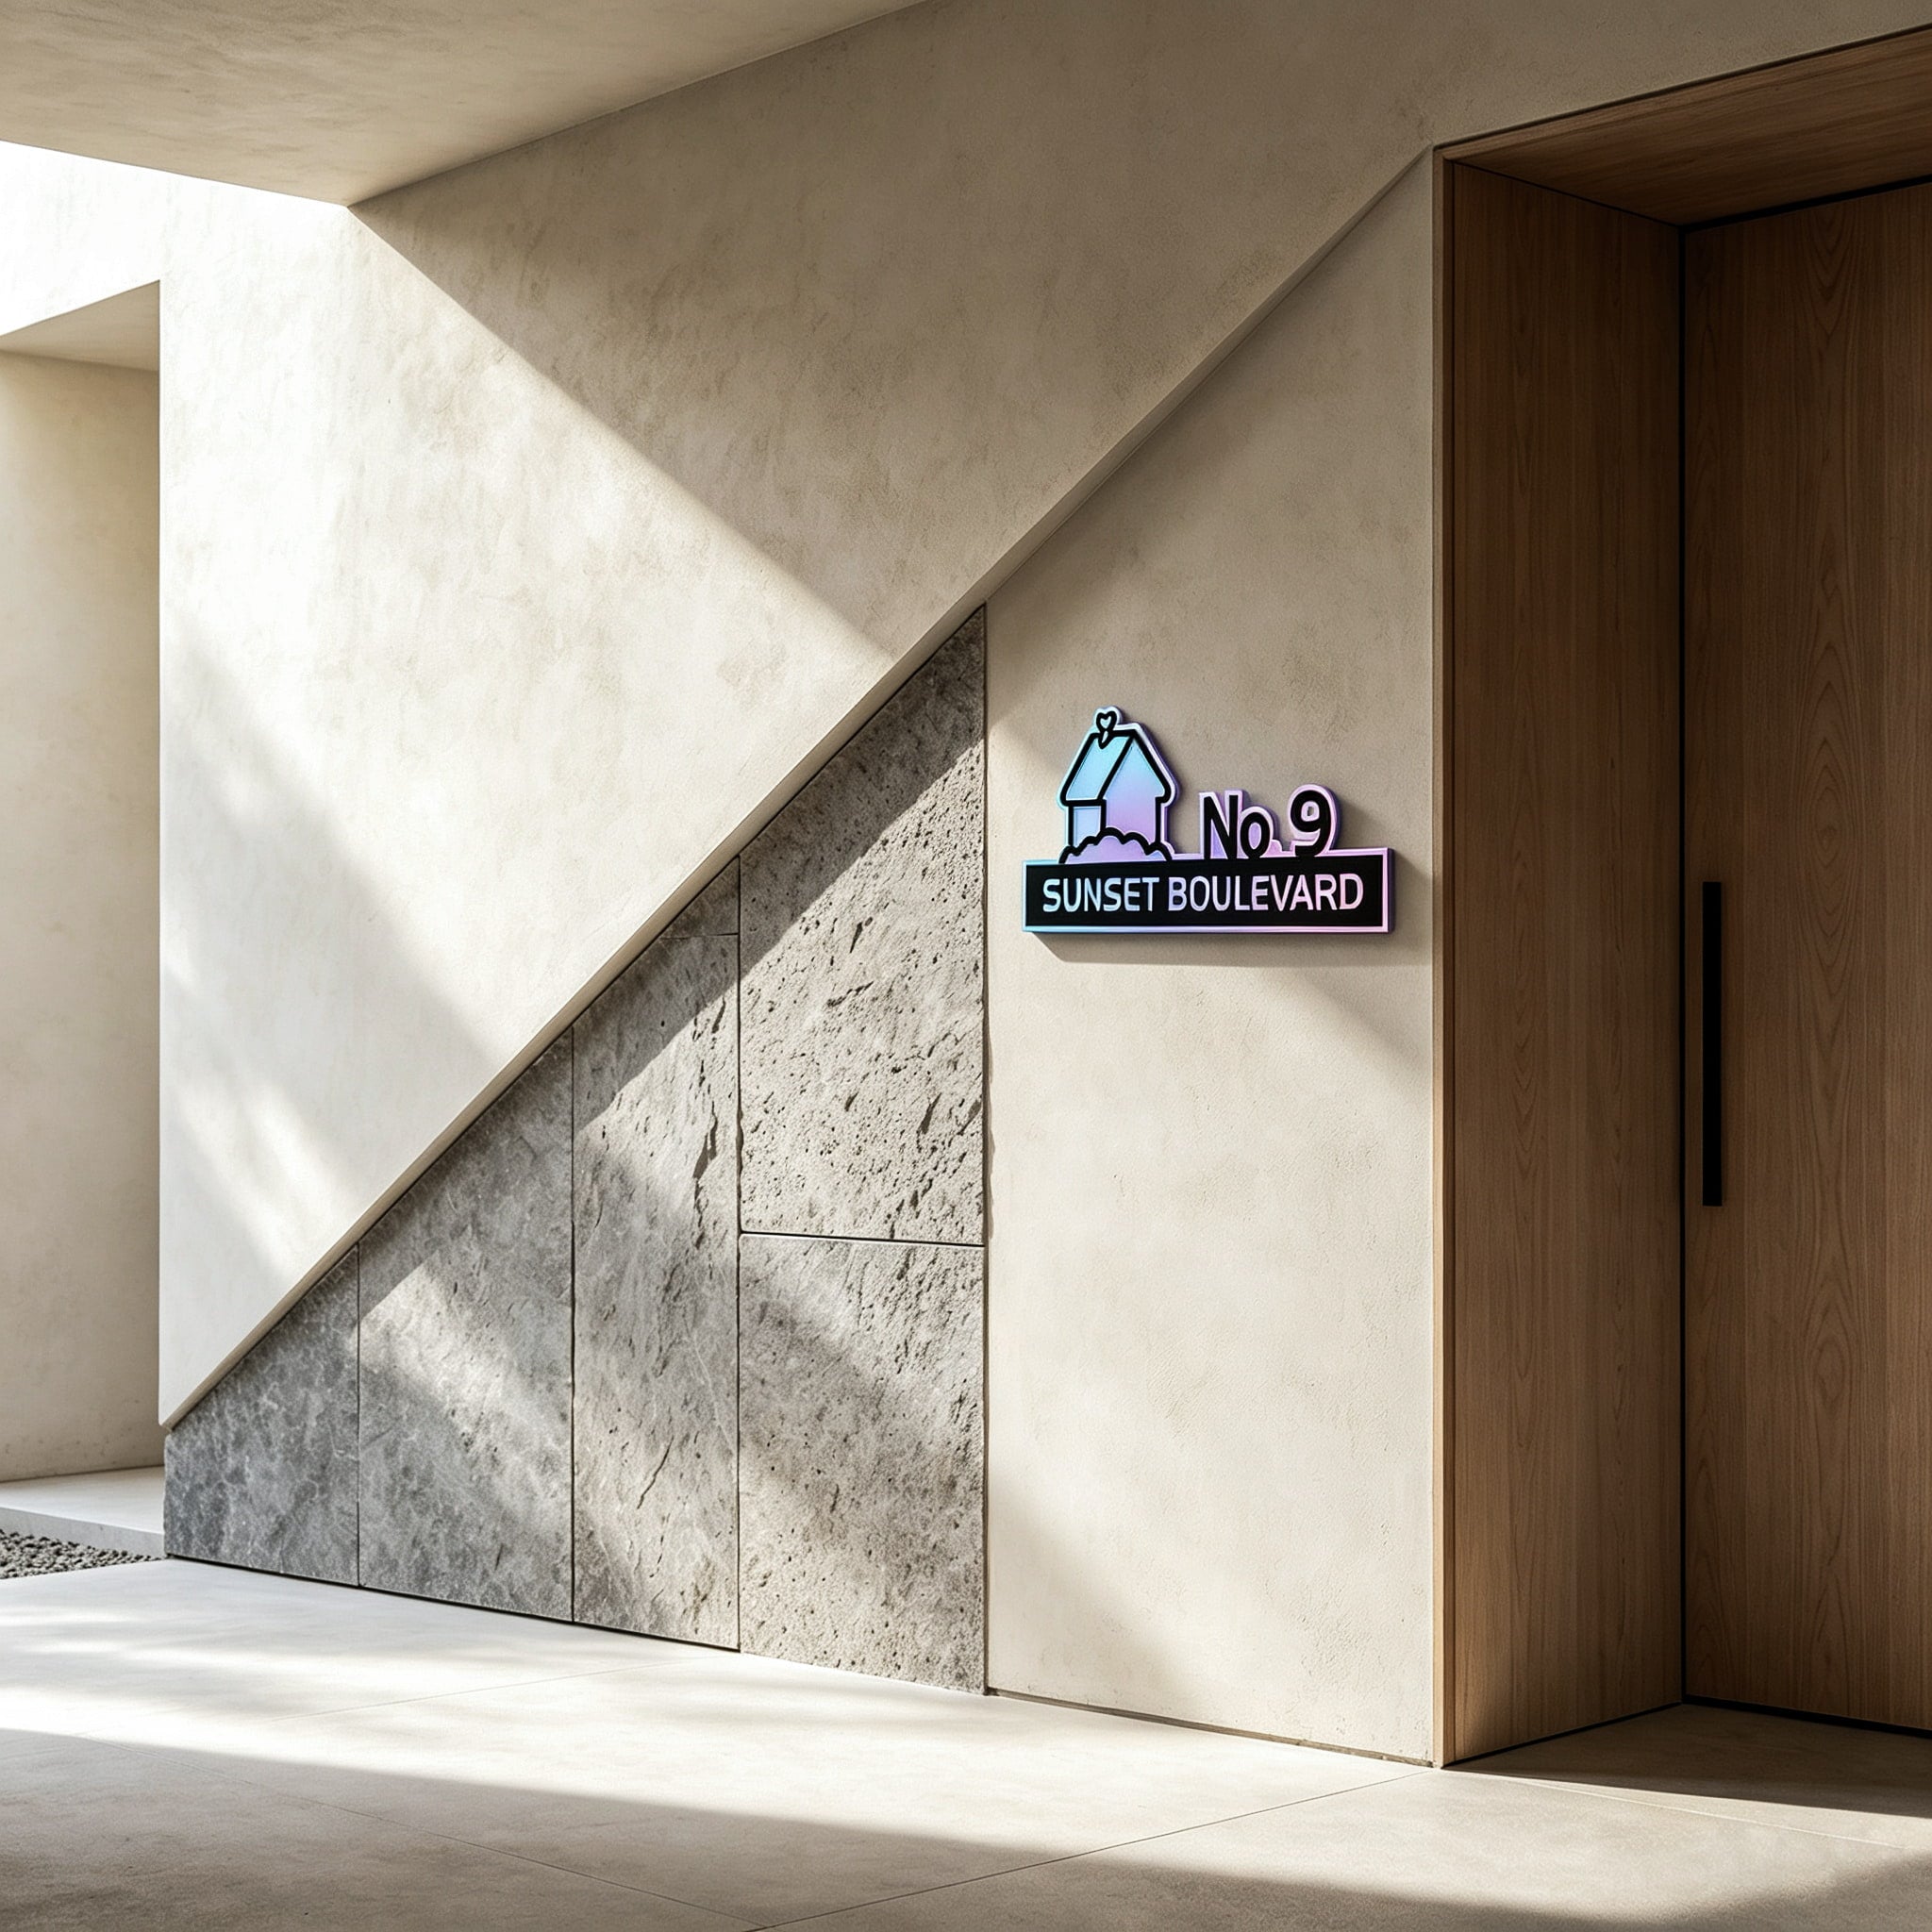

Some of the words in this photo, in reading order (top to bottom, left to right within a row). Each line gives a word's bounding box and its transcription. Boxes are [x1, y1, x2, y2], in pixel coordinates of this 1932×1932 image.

[1290, 790, 1332, 858] 9
[1042, 876, 1159, 913] SUNSET
[1168, 874, 1364, 912] BOULEVARD
